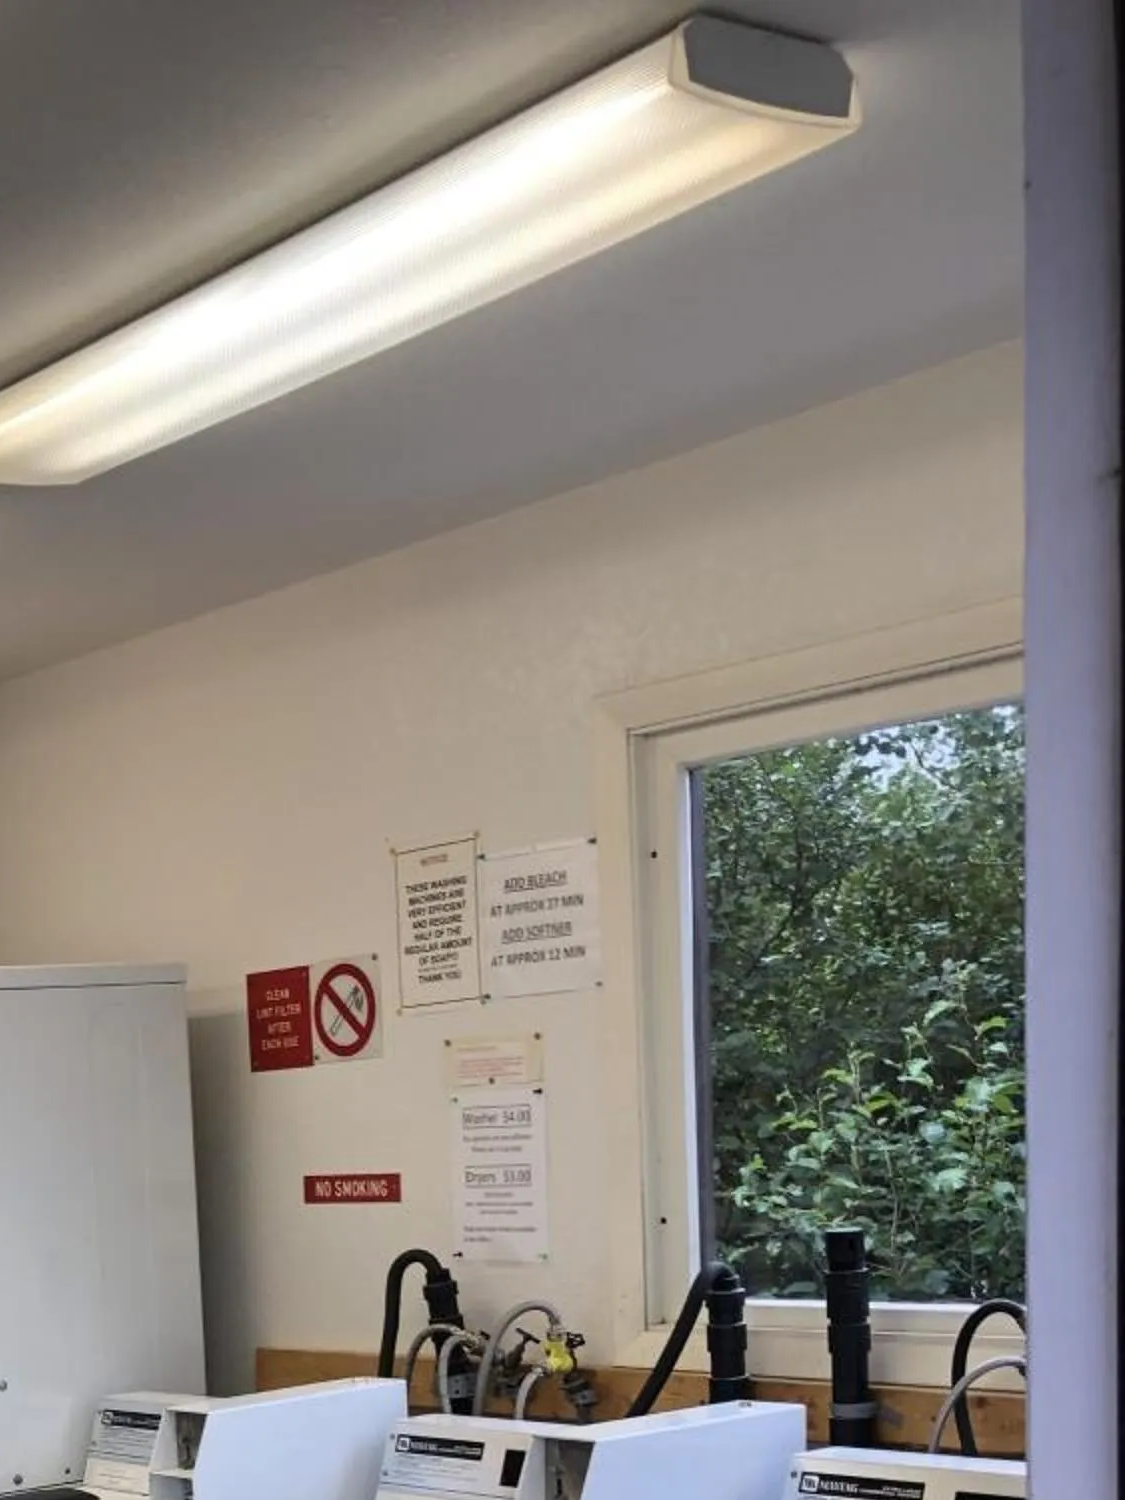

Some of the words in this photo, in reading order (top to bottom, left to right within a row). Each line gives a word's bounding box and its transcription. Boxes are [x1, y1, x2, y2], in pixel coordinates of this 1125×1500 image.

[504, 877, 526, 891] ADD
[527, 870, 567, 889] BLEACH
[428, 899, 467, 915] EFFICIENT
[490, 905, 503, 918] AT
[505, 900, 544, 915] APPROX
[561, 893, 584, 907] MIN
[502, 927, 524, 941] ADD
[526, 921, 572, 939] SOFTNER
[441, 936, 473, 951] AMOUNT
[490, 955, 504, 967] AT
[506, 950, 546, 965] APPROX
[563, 945, 586, 958] MIN
[418, 972, 443, 984] THANK
[445, 969, 463, 981] YOU
[266, 988, 290, 1002] CLEAN
[256, 1007, 274, 1020] LINT
[275, 1003, 302, 1017] FILTER
[268, 1021, 292, 1035] AFTER
[261, 1038, 282, 1051] EACH
[283, 1035, 300, 1049] USE
[462, 1111, 497, 1124] Washer
[315, 1180, 332, 1197] NO
[334, 1179, 388, 1198] SMOKING
